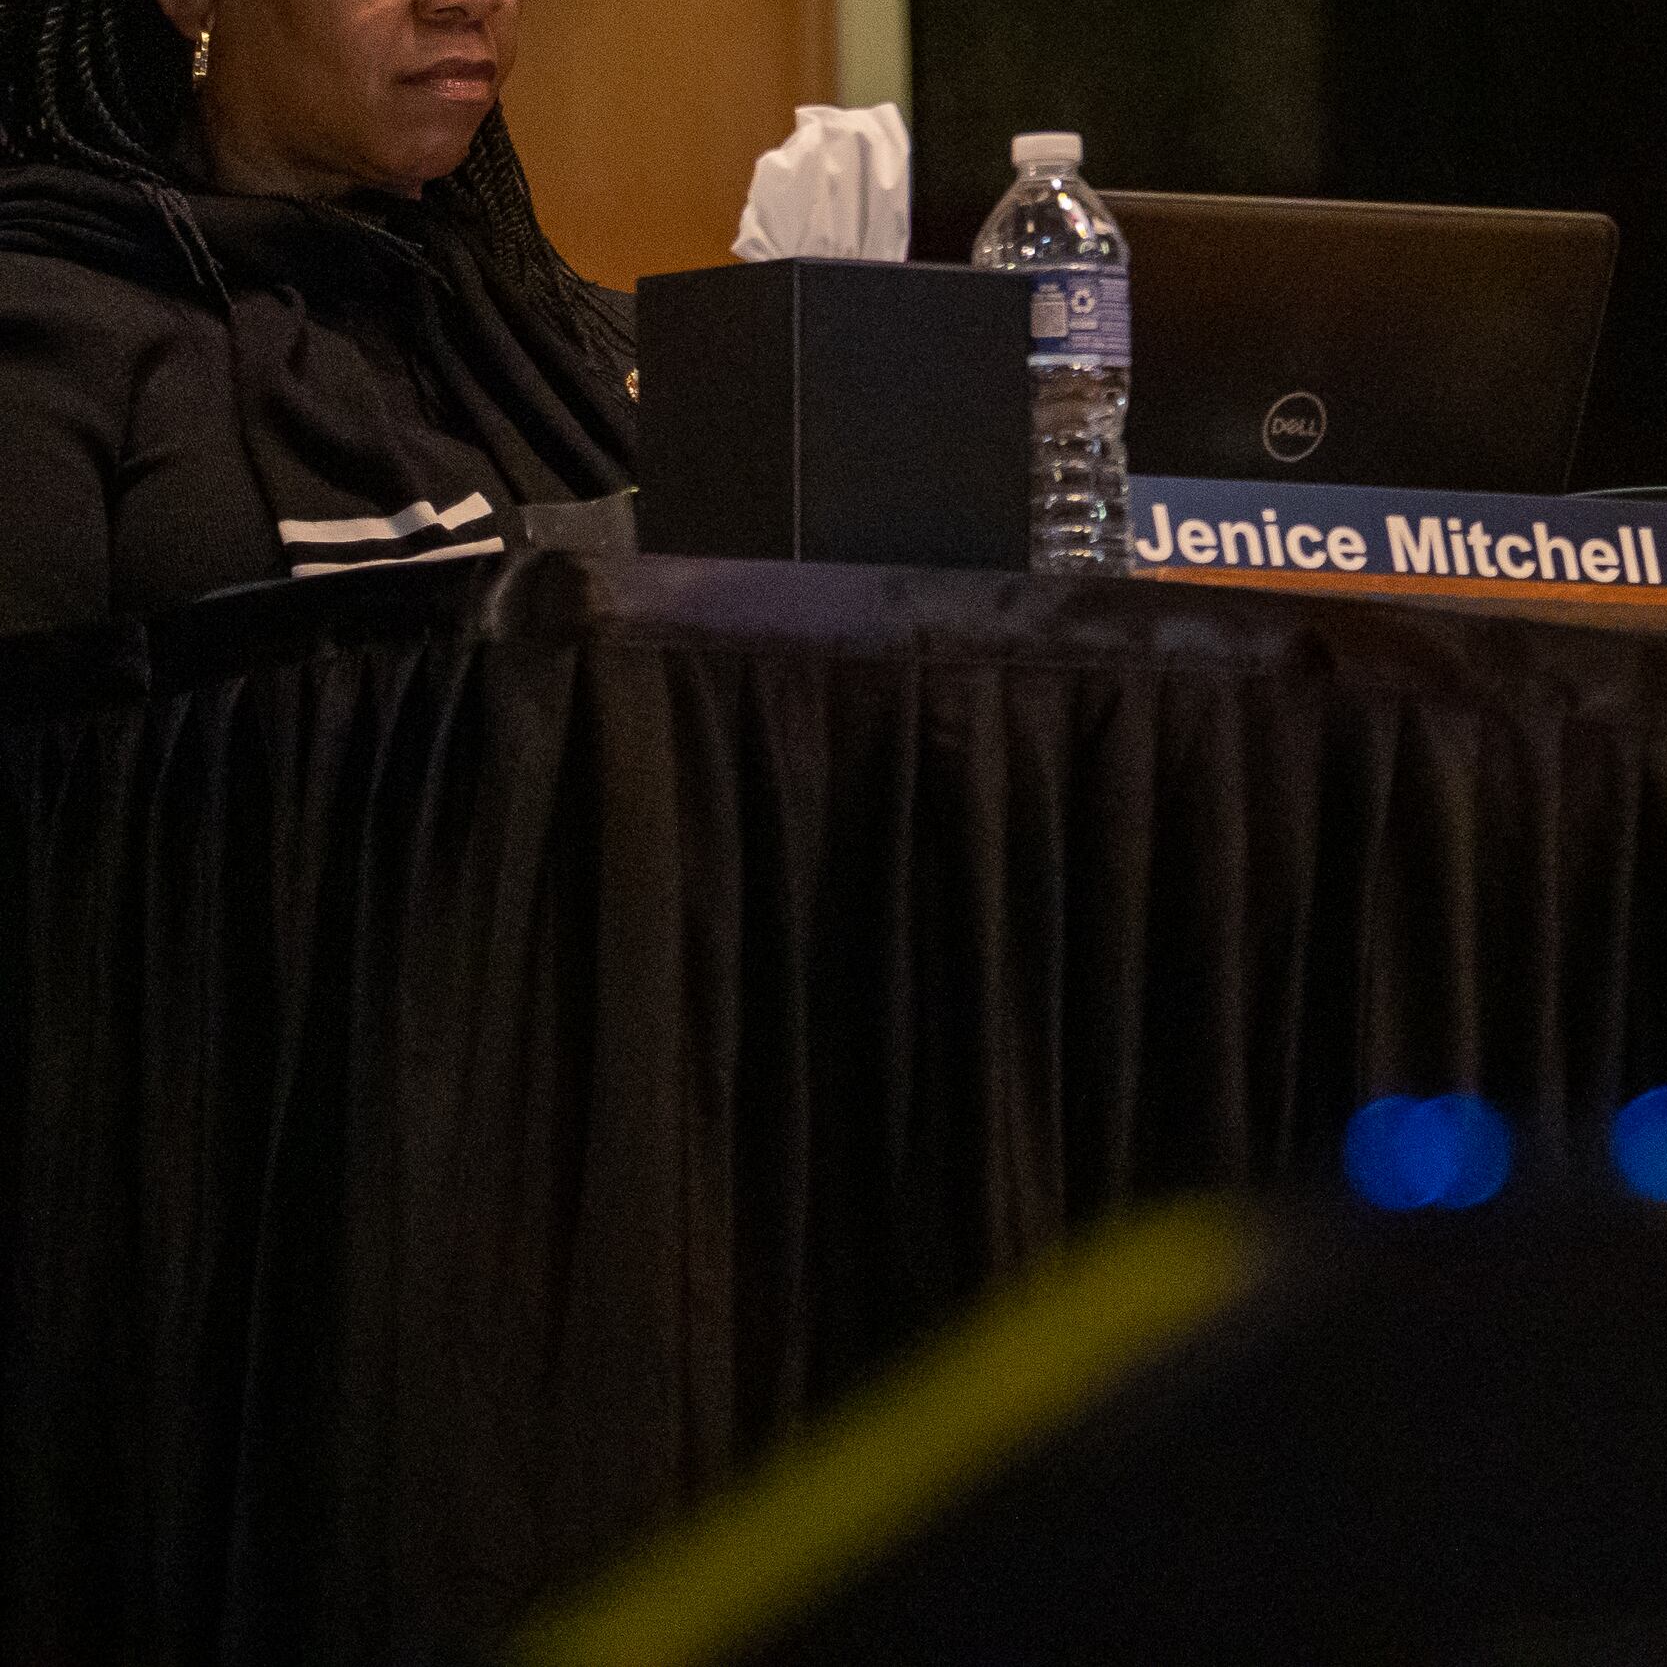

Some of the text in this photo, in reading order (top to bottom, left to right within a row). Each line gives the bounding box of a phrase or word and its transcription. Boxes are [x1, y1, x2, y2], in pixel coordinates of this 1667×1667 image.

[1272, 417, 1320, 436] DELL
[1136, 503, 1368, 572] Jenice
[1386, 514, 1662, 584] Mitchell
